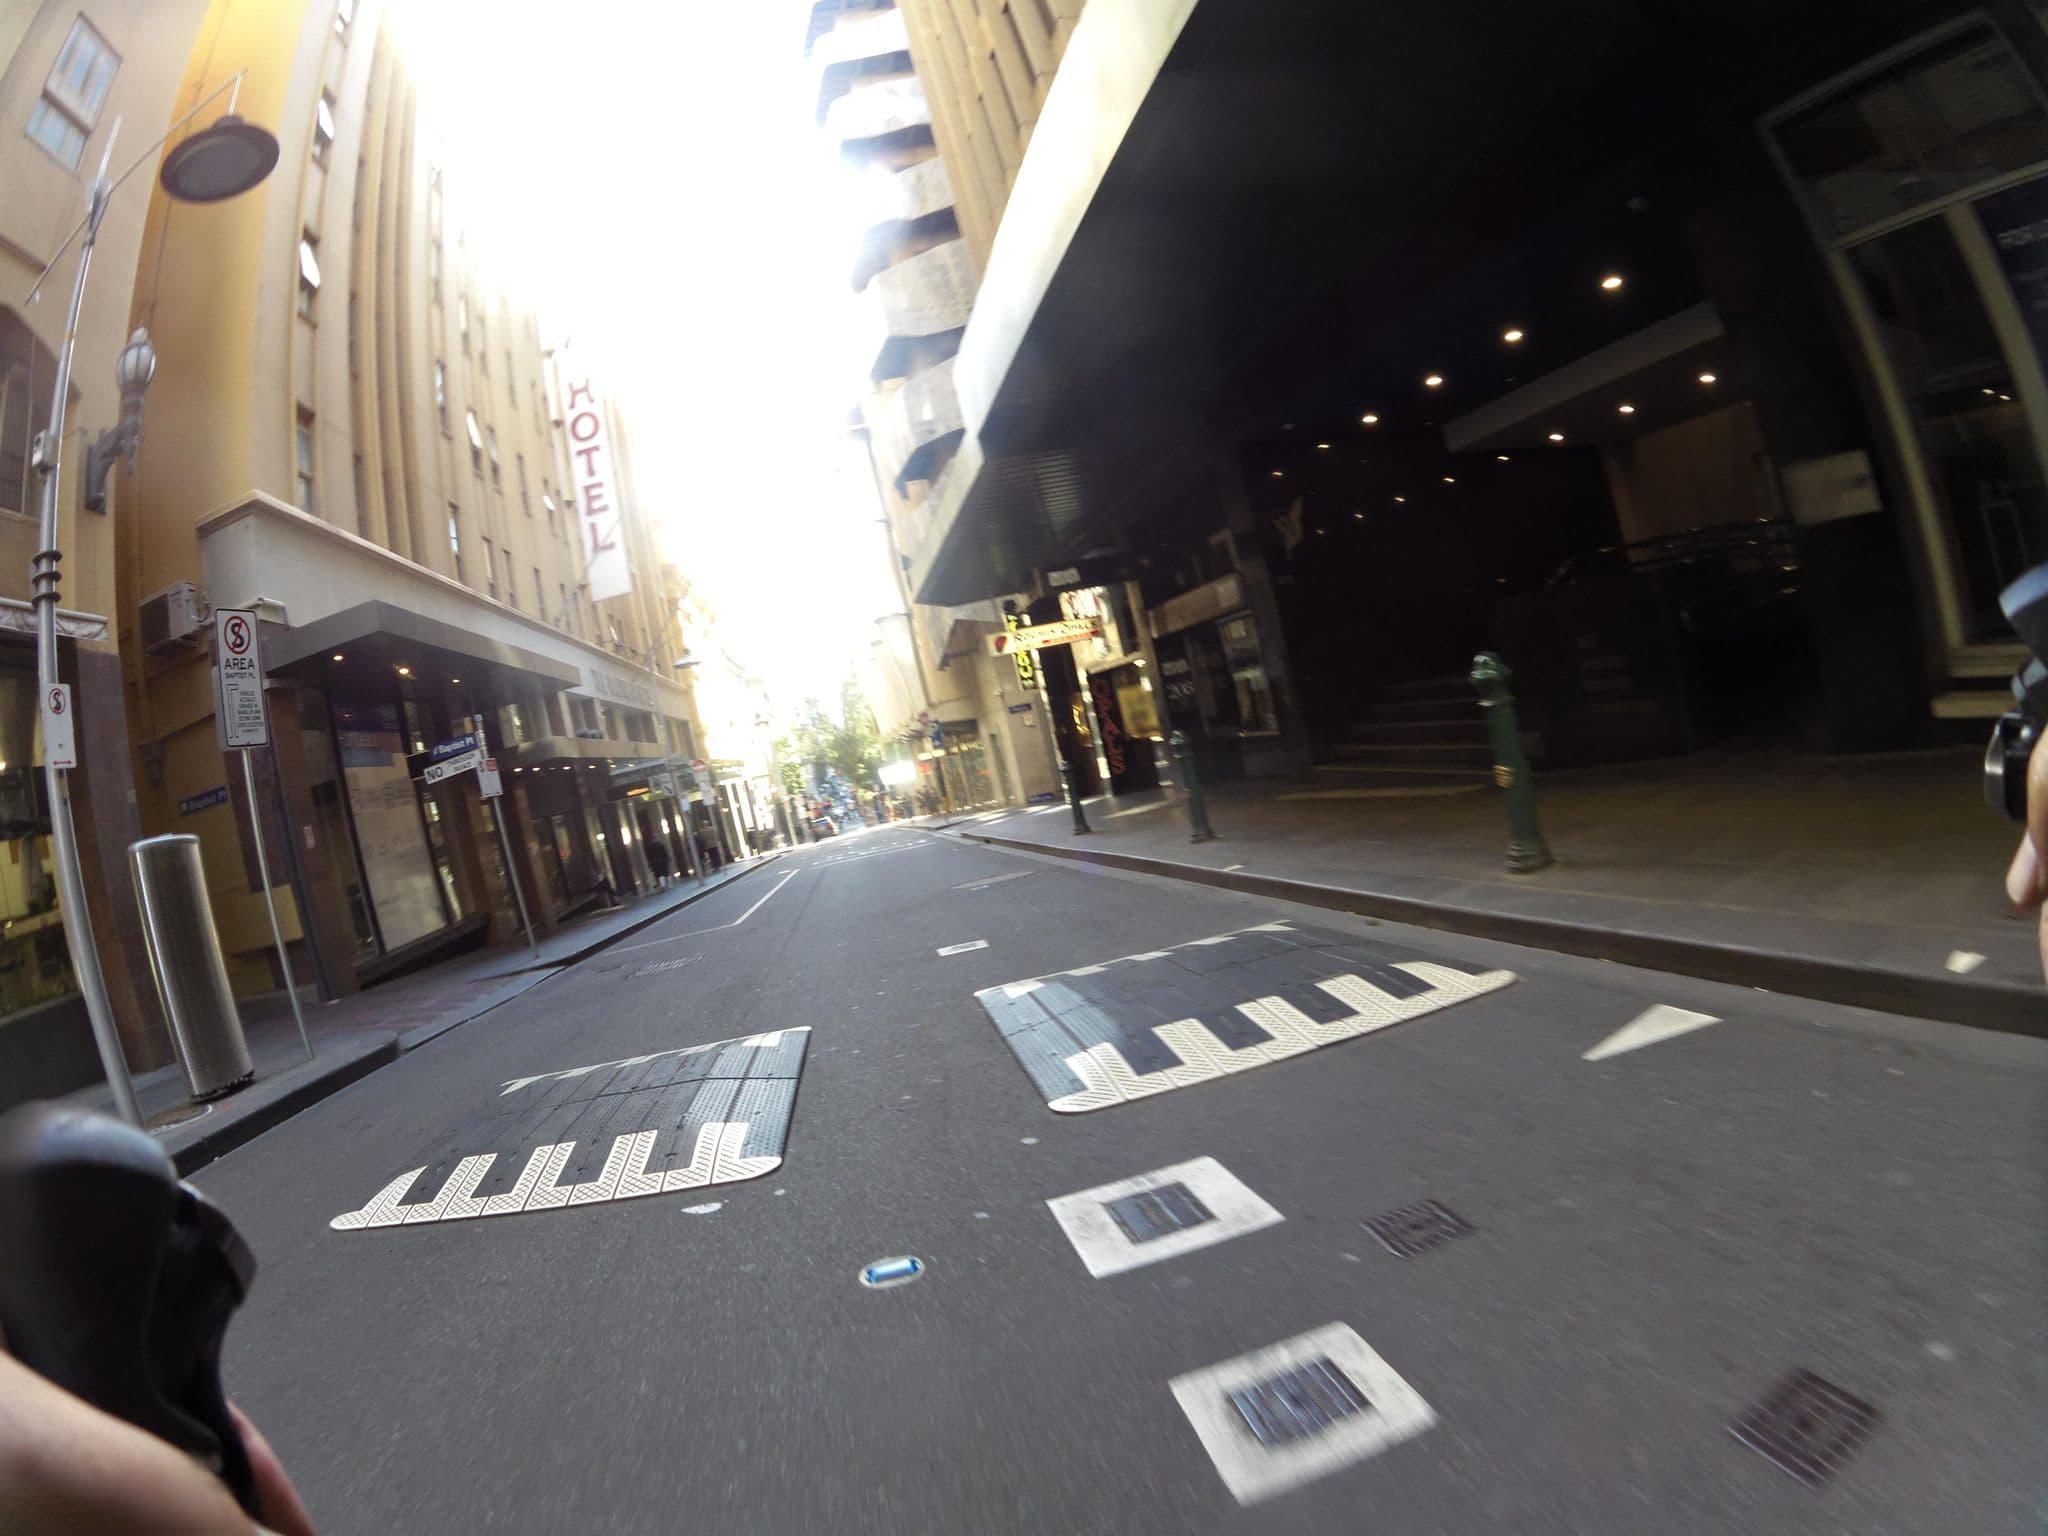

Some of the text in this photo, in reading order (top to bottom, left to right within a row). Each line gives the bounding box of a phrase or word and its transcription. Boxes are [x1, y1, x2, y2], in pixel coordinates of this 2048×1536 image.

[568, 377, 616, 554] HOTEL
[224, 657, 256, 670] AREA
[1090, 679, 1128, 775] OPALS
[439, 736, 474, 754] Baptist Pl
[426, 766, 443, 780] NO
[454, 761, 472, 771] ROAD
